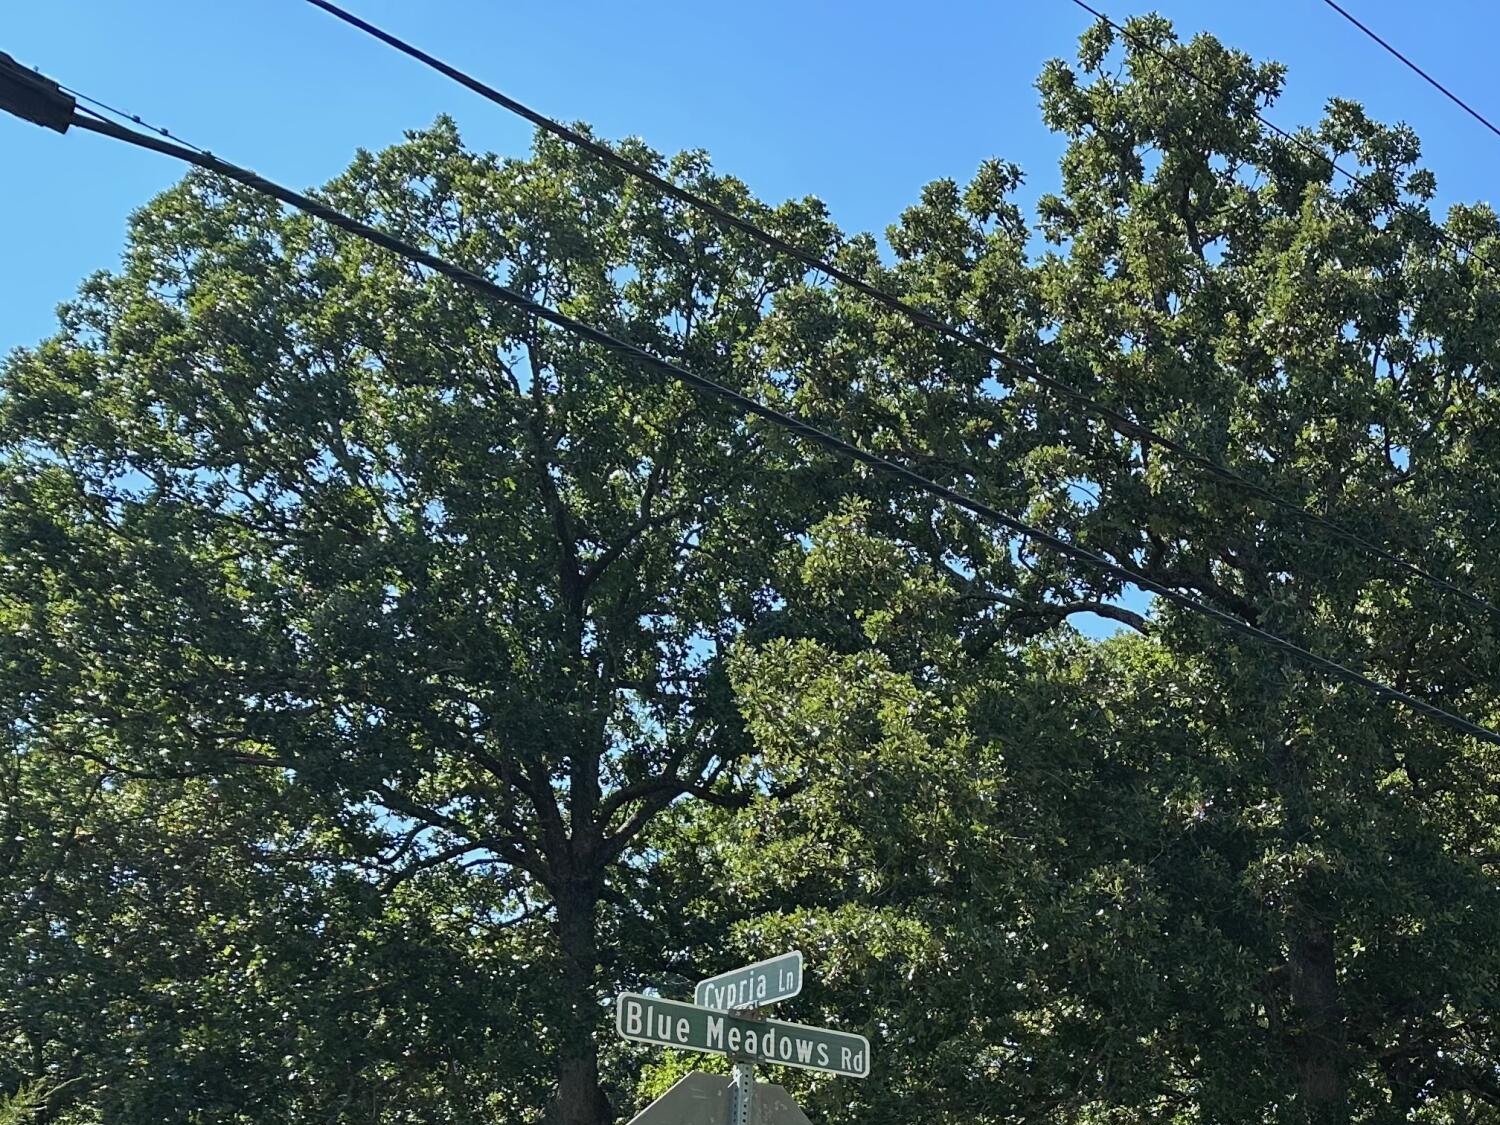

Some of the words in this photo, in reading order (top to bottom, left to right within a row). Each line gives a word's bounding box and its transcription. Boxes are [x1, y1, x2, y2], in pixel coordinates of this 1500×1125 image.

[705, 970, 767, 1010] Cypria
[778, 968, 795, 993] Ln
[627, 1002, 690, 1043] Blue
[706, 1016, 829, 1067] Meadows
[841, 1047, 863, 1072] Rd
